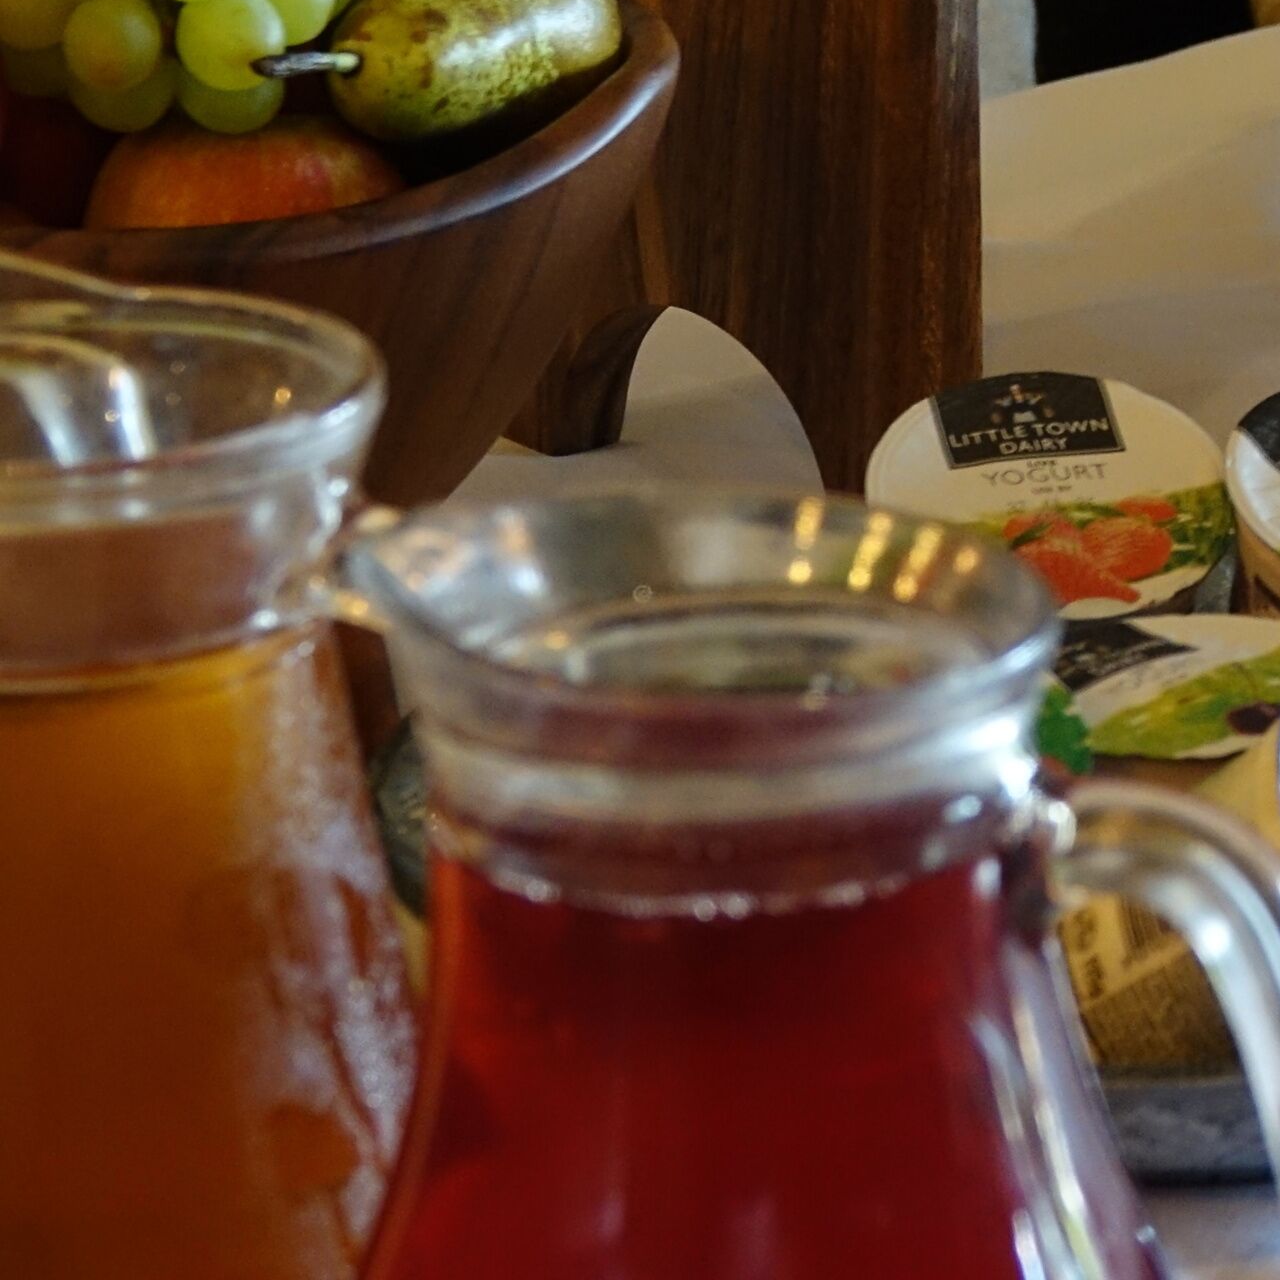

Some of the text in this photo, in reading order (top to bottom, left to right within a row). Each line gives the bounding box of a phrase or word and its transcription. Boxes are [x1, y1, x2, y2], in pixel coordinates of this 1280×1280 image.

[949, 417, 1109, 449] LITTLE TOWN
[999, 436, 1070, 455] DAIRY
[979, 461, 1108, 487] YOGURT
